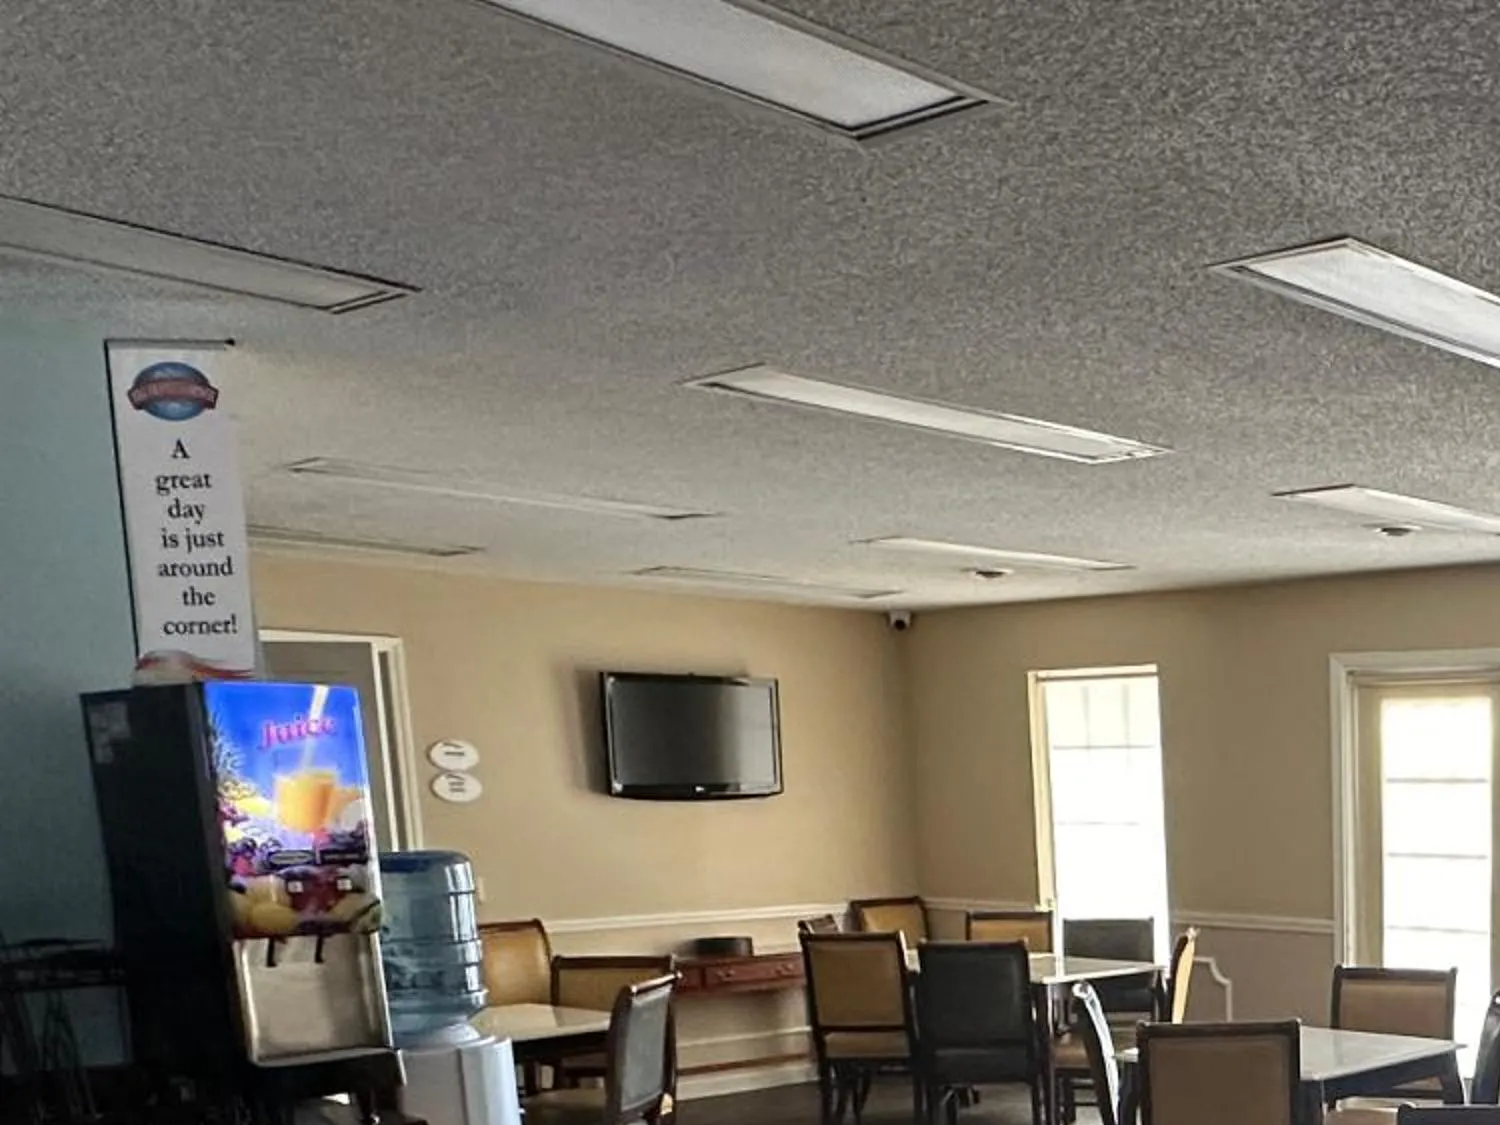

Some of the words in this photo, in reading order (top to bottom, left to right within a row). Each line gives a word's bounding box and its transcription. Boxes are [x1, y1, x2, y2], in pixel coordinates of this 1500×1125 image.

[171, 439, 190, 460] A
[155, 472, 212, 496] great
[167, 500, 206, 525] day
[161, 528, 179, 549] is
[185, 527, 224, 554] just
[158, 556, 234, 578] around
[182, 586, 216, 607] the
[163, 613, 238, 636] corner!
[256, 713, 338, 752] Juice
